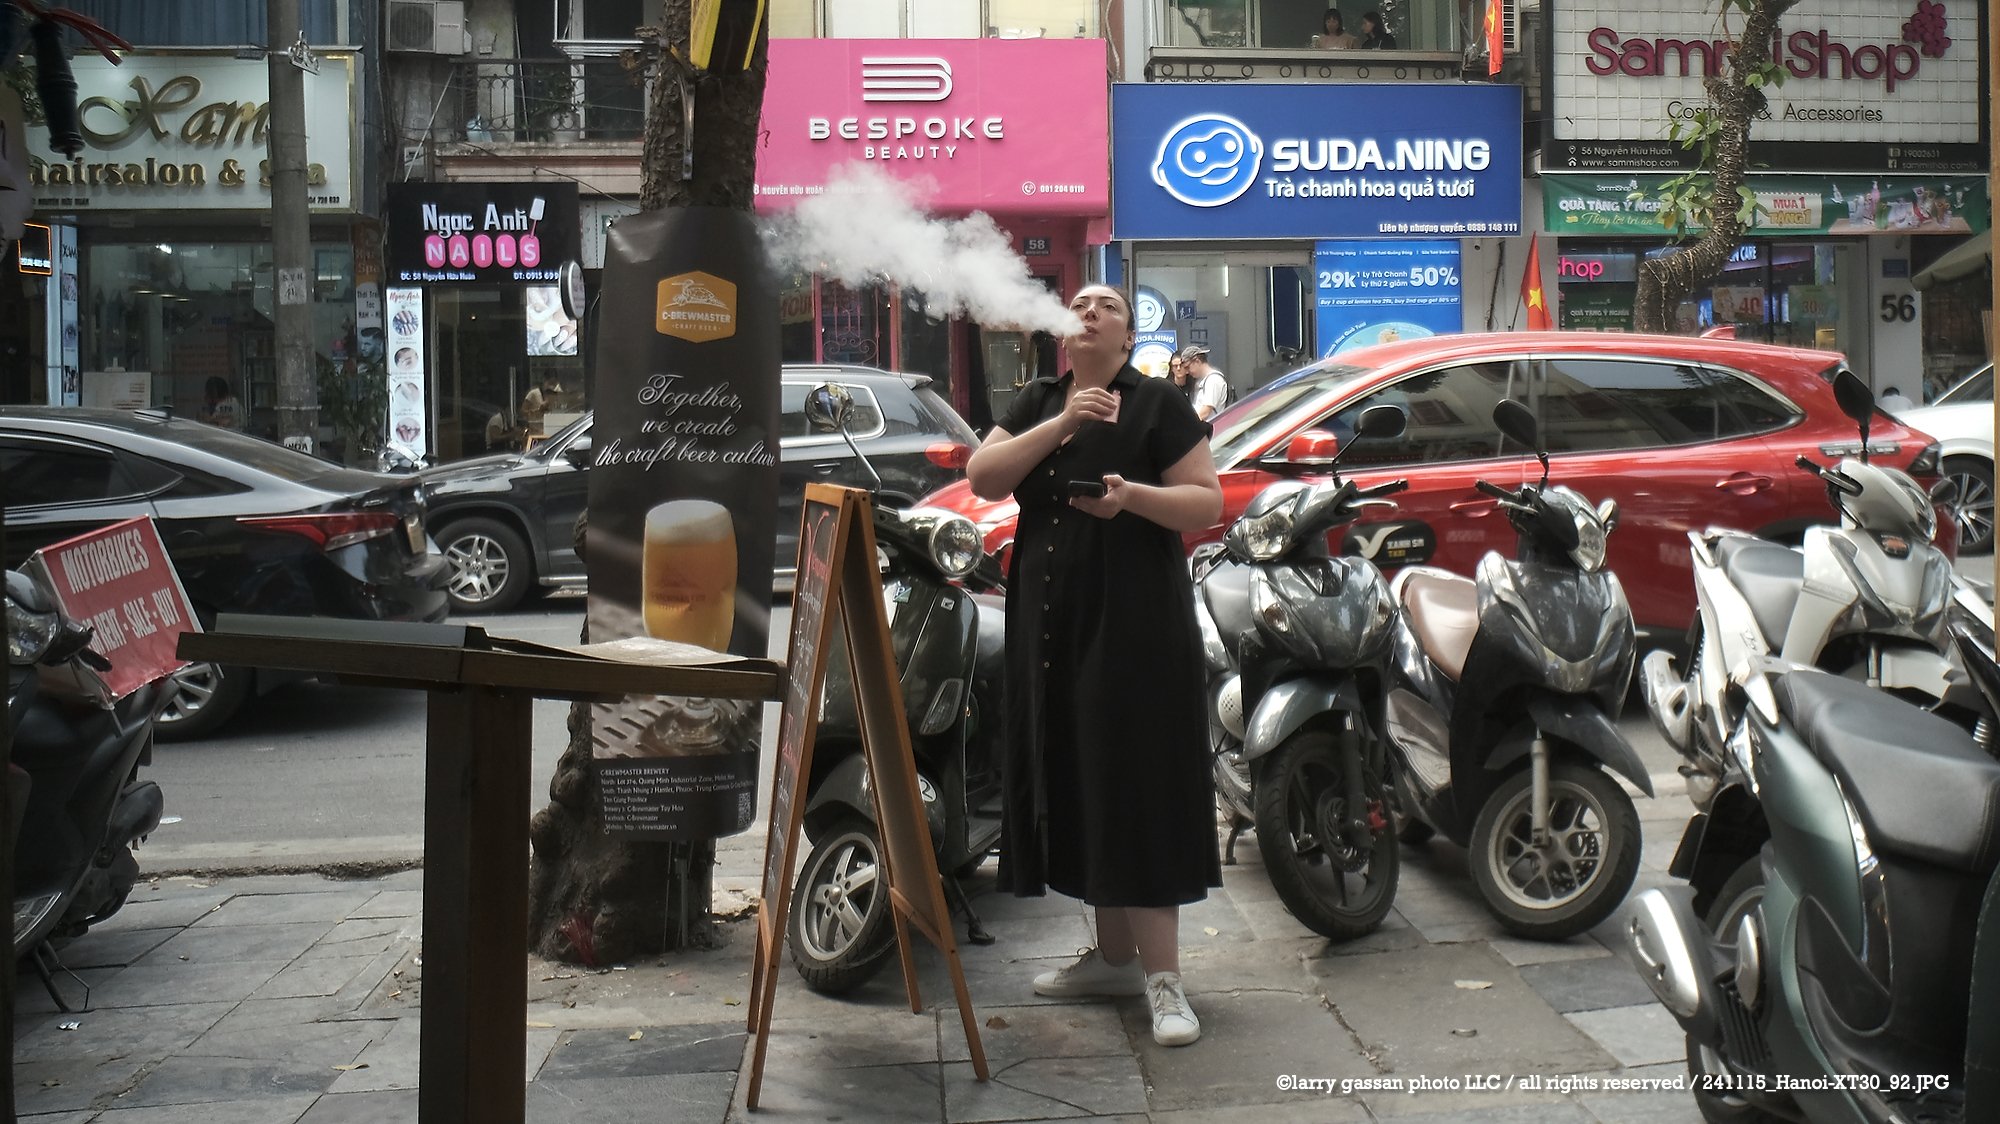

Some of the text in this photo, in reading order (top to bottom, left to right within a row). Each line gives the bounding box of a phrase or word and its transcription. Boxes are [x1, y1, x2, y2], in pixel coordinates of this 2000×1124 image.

[1784, 103, 1883, 121] Accessories
[809, 117, 1005, 141] BESPOKE
[865, 146, 957, 160] BEAUTY
[1273, 139, 1491, 172] SUDA.NING
[1581, 147, 1592, 155] 56
[217, 158, 245, 187] &
[1608, 159, 1680, 168] sammishop.com
[1264, 175, 1475, 201] Trà chanh hoa quả tươi
[1559, 198, 1586, 212] QUÀ
[1586, 199, 1621, 213] TẶNG
[1773, 196, 1806, 210] MUA 1
[422, 203, 529, 239] Ngọc Anh
[427, 243, 537, 262] NAILS
[1029, 239, 1045, 250] 58
[1319, 271, 1357, 289] 29k
[1389, 280, 1408, 289] giảm
[1409, 267, 1459, 287] 50%
[662, 310, 731, 324] C-BREWMASTER
[1880, 294, 1916, 323] 56
[637, 373, 742, 416] Together,
[641, 415, 738, 437] we create
[594, 437, 625, 467] the
[625, 435, 678, 472] craft
[677, 437, 720, 464] beer
[60, 528, 150, 594] MOTORBIKES
[94, 608, 128, 652] RENT
[123, 597, 157, 639] SALE
[152, 587, 181, 628] BUY
[643, 767, 670, 776] BREWERY
